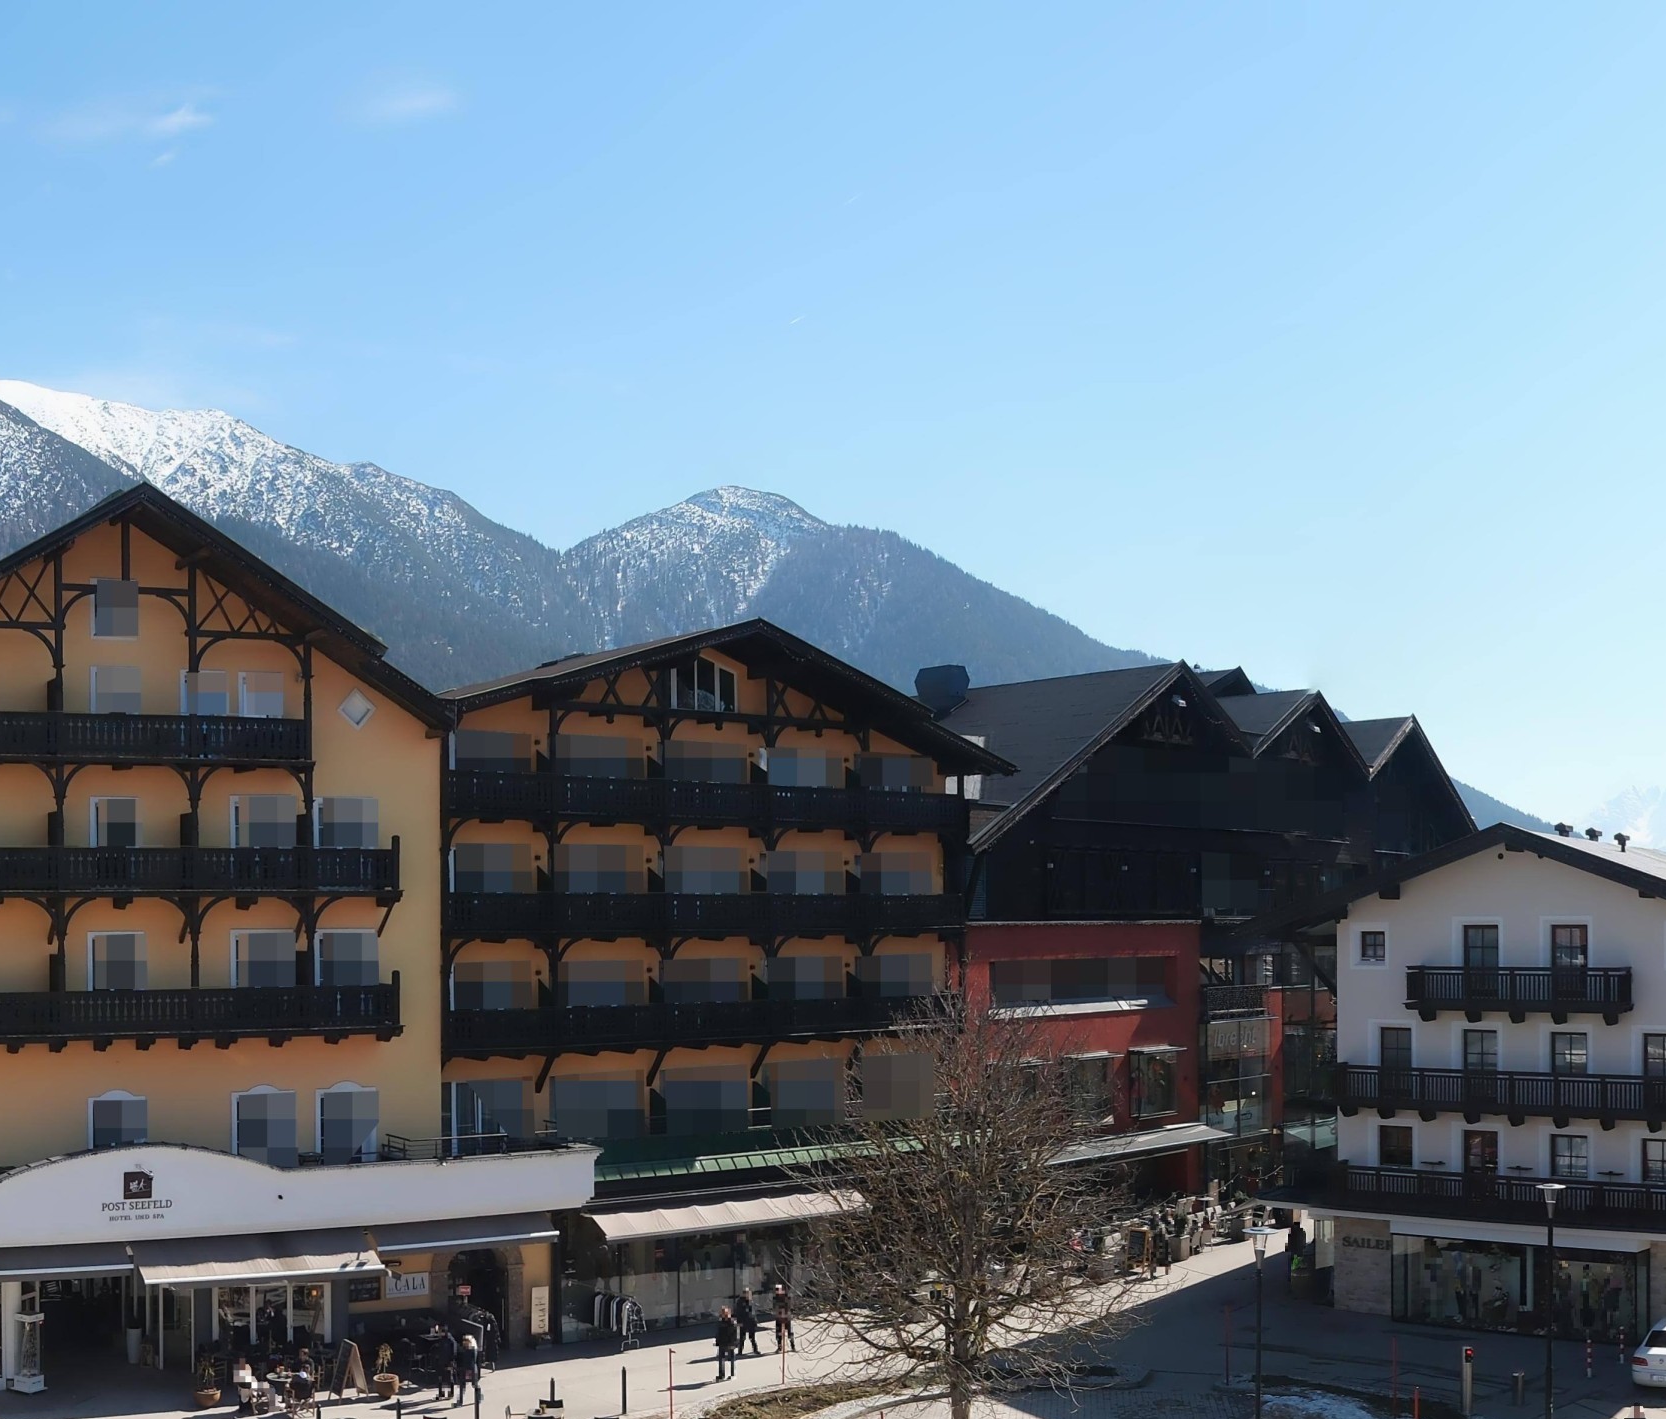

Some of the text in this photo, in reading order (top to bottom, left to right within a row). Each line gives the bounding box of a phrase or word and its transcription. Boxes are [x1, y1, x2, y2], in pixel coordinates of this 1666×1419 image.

[101, 1199, 173, 1211] POST SEEFELD
[395, 1276, 426, 1292] CALA
